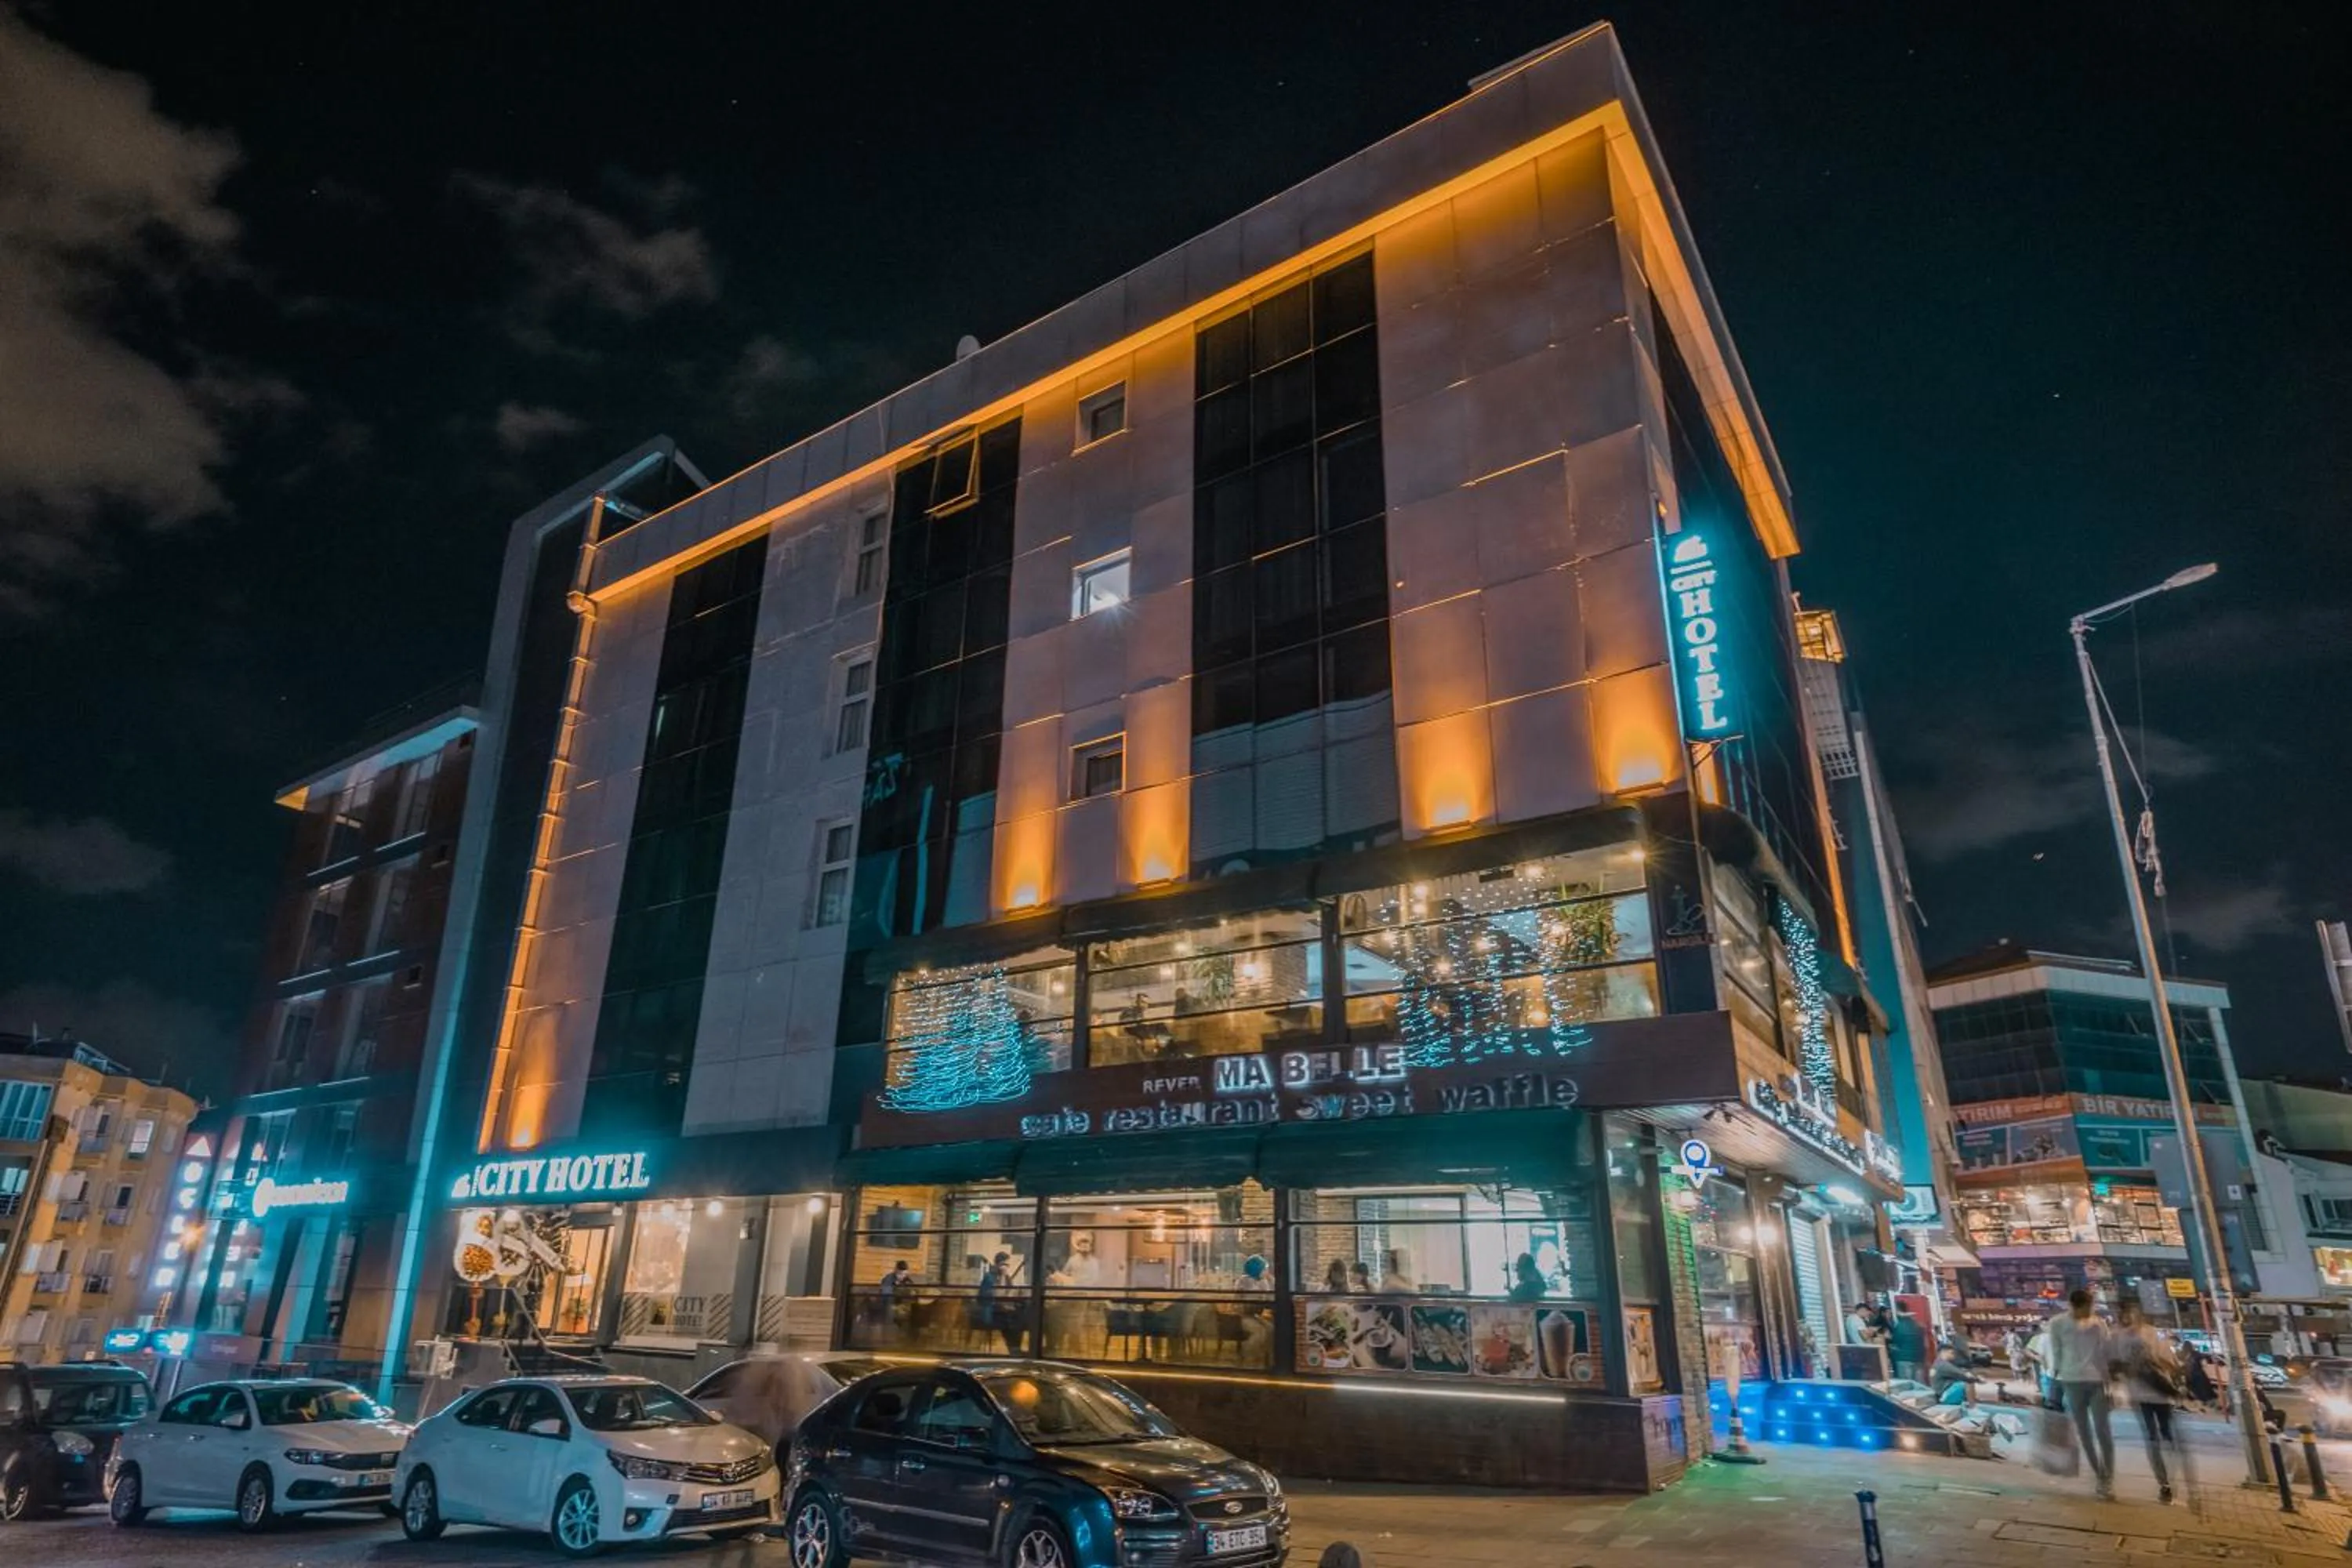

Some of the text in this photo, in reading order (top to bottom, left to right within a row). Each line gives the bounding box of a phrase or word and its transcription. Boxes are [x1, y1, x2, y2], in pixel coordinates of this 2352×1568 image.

[1679, 587, 1728, 730] HOTEL
[1214, 1054, 1273, 1092] MA
[1282, 1044, 1408, 1087] BELLE
[1103, 1091, 1280, 1131] restaurant
[1295, 1084, 1414, 1121] sweet
[1436, 1072, 1580, 1113] waffle
[477, 1152, 651, 1196] CITY HOTEL
[673, 1296, 705, 1312] CITY
